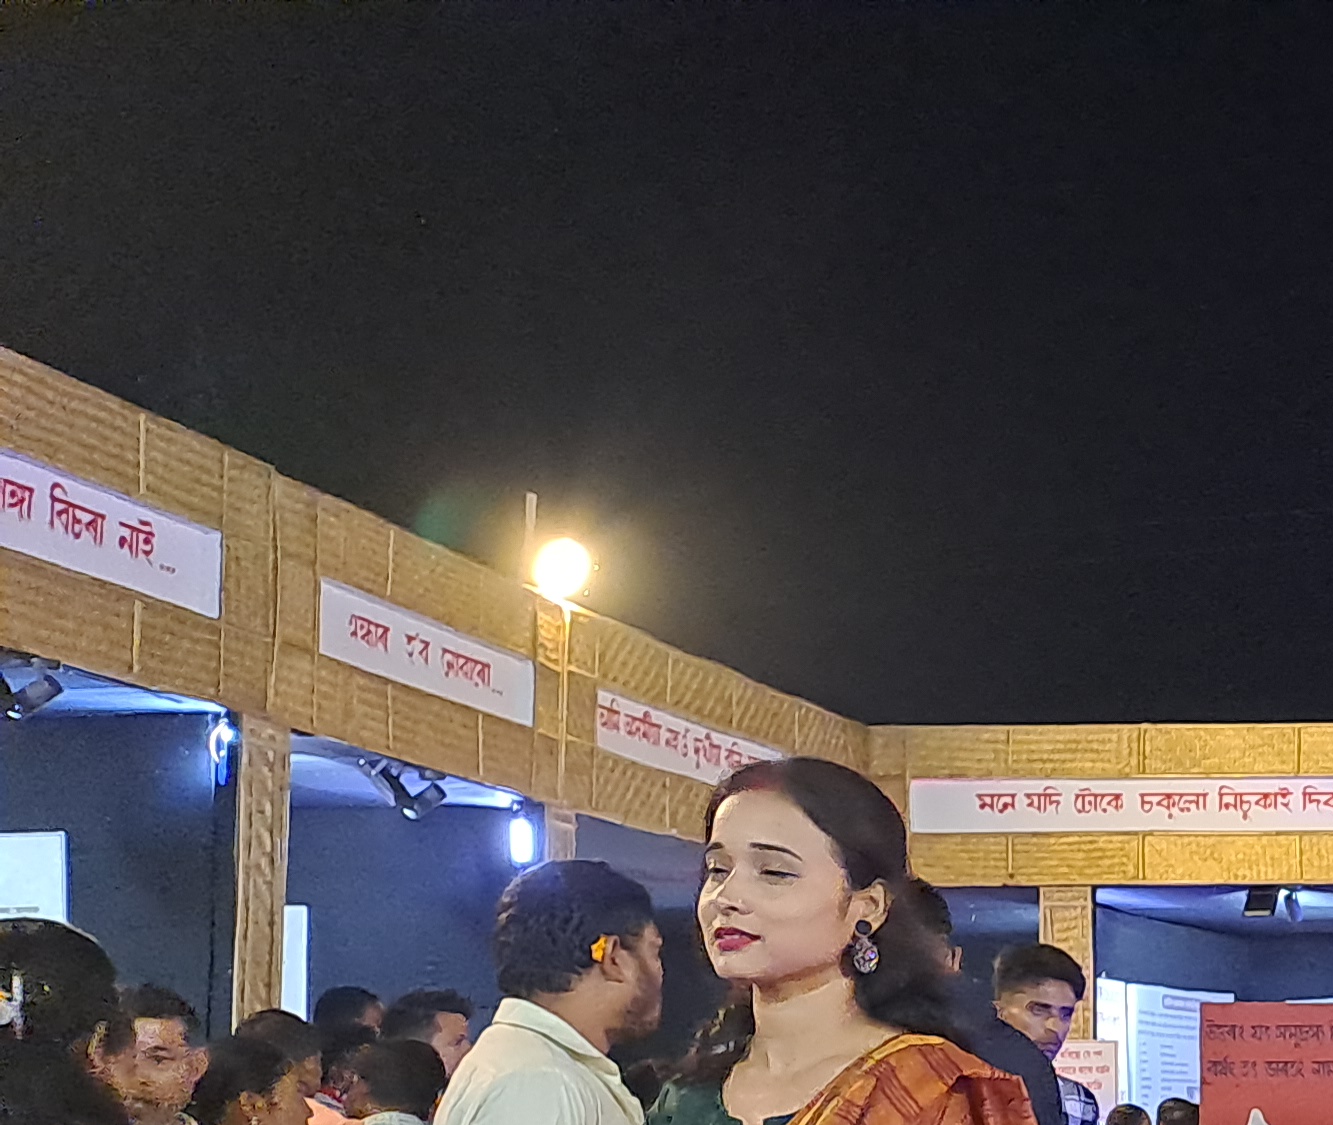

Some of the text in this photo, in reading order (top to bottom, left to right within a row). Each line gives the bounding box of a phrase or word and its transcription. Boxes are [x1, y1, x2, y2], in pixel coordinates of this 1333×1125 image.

[975, 792, 1018, 814] মনে
[1023, 785, 1062, 815] যদি
[1217, 784, 1294, 821] নিচুকাই
